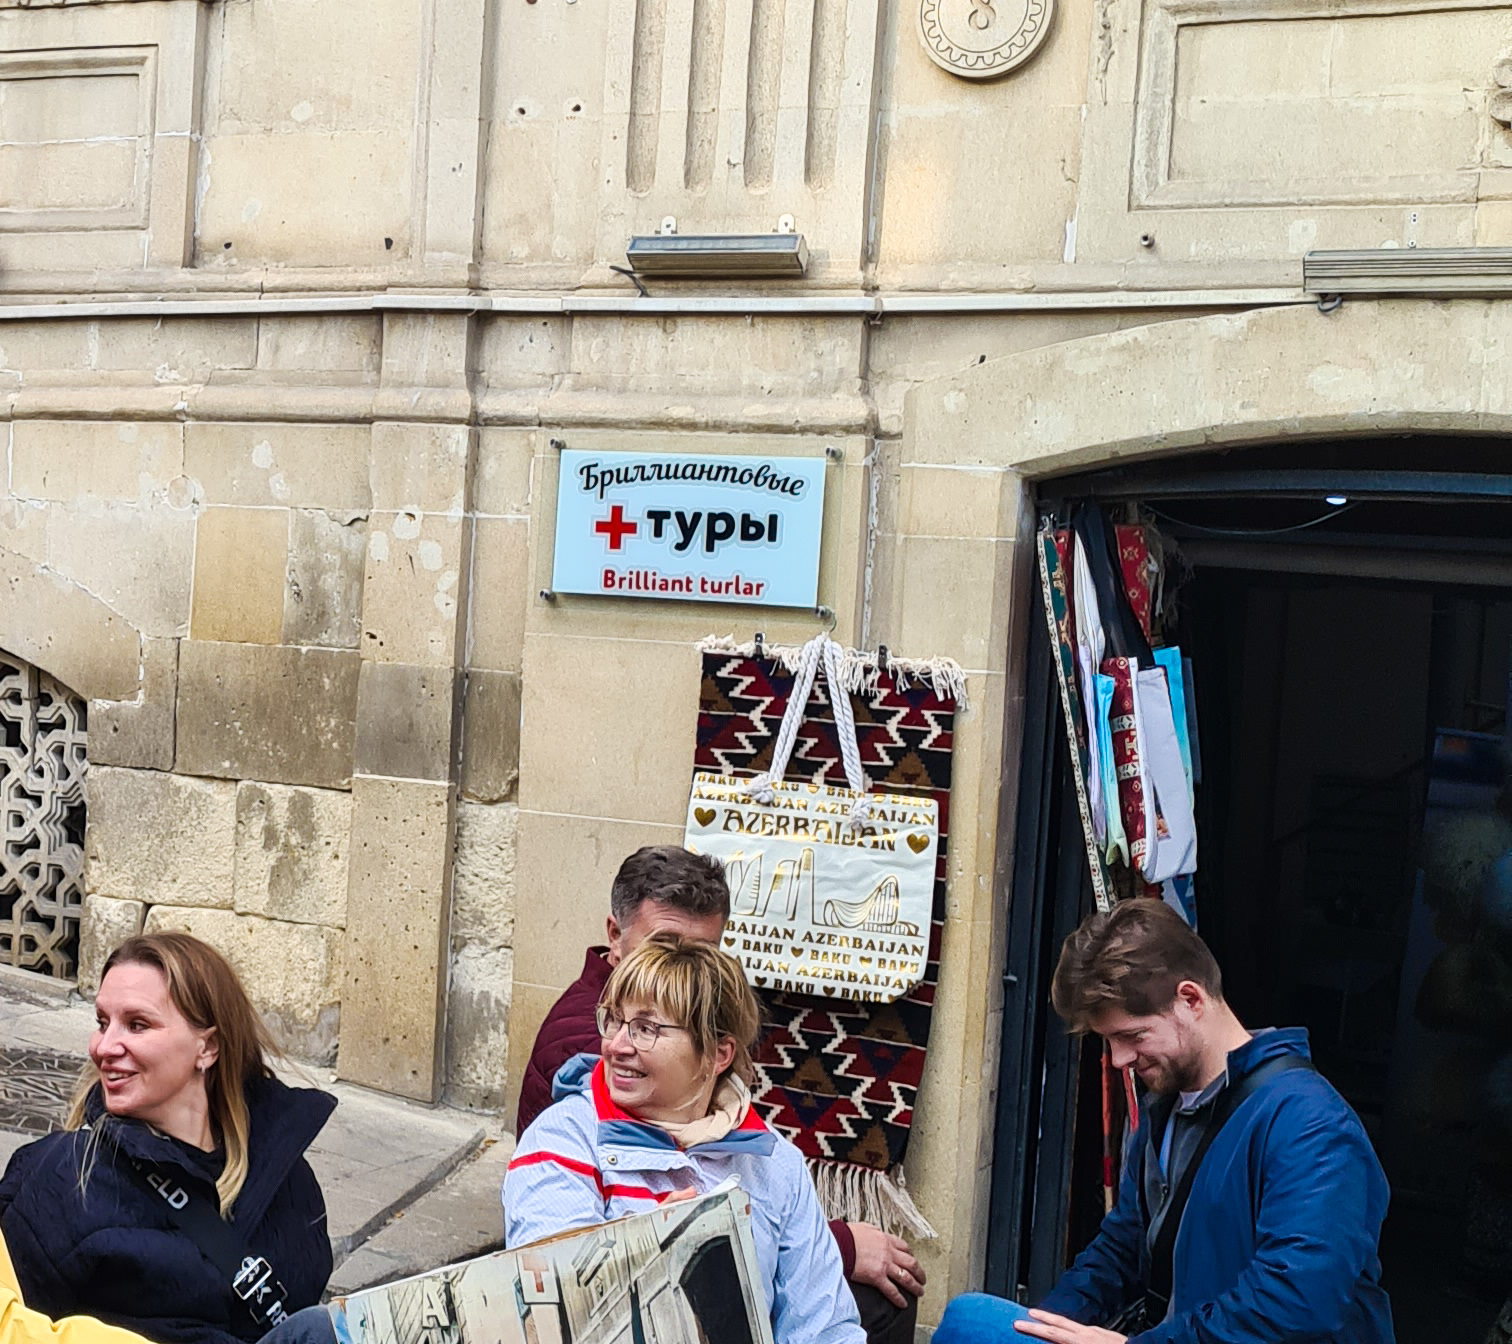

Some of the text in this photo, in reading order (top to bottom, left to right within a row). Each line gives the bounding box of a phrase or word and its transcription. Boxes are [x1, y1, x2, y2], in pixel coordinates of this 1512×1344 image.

[578, 461, 804, 499] Бриллиантовые
[646, 508, 779, 553] туры
[602, 569, 765, 596] Brilliant turlar
[722, 808, 899, 851] AZERBAIJAN
[724, 920, 925, 957] BAIJAN AZERBAIJAN
[742, 939, 920, 974] BAKU BAKU BAKU
